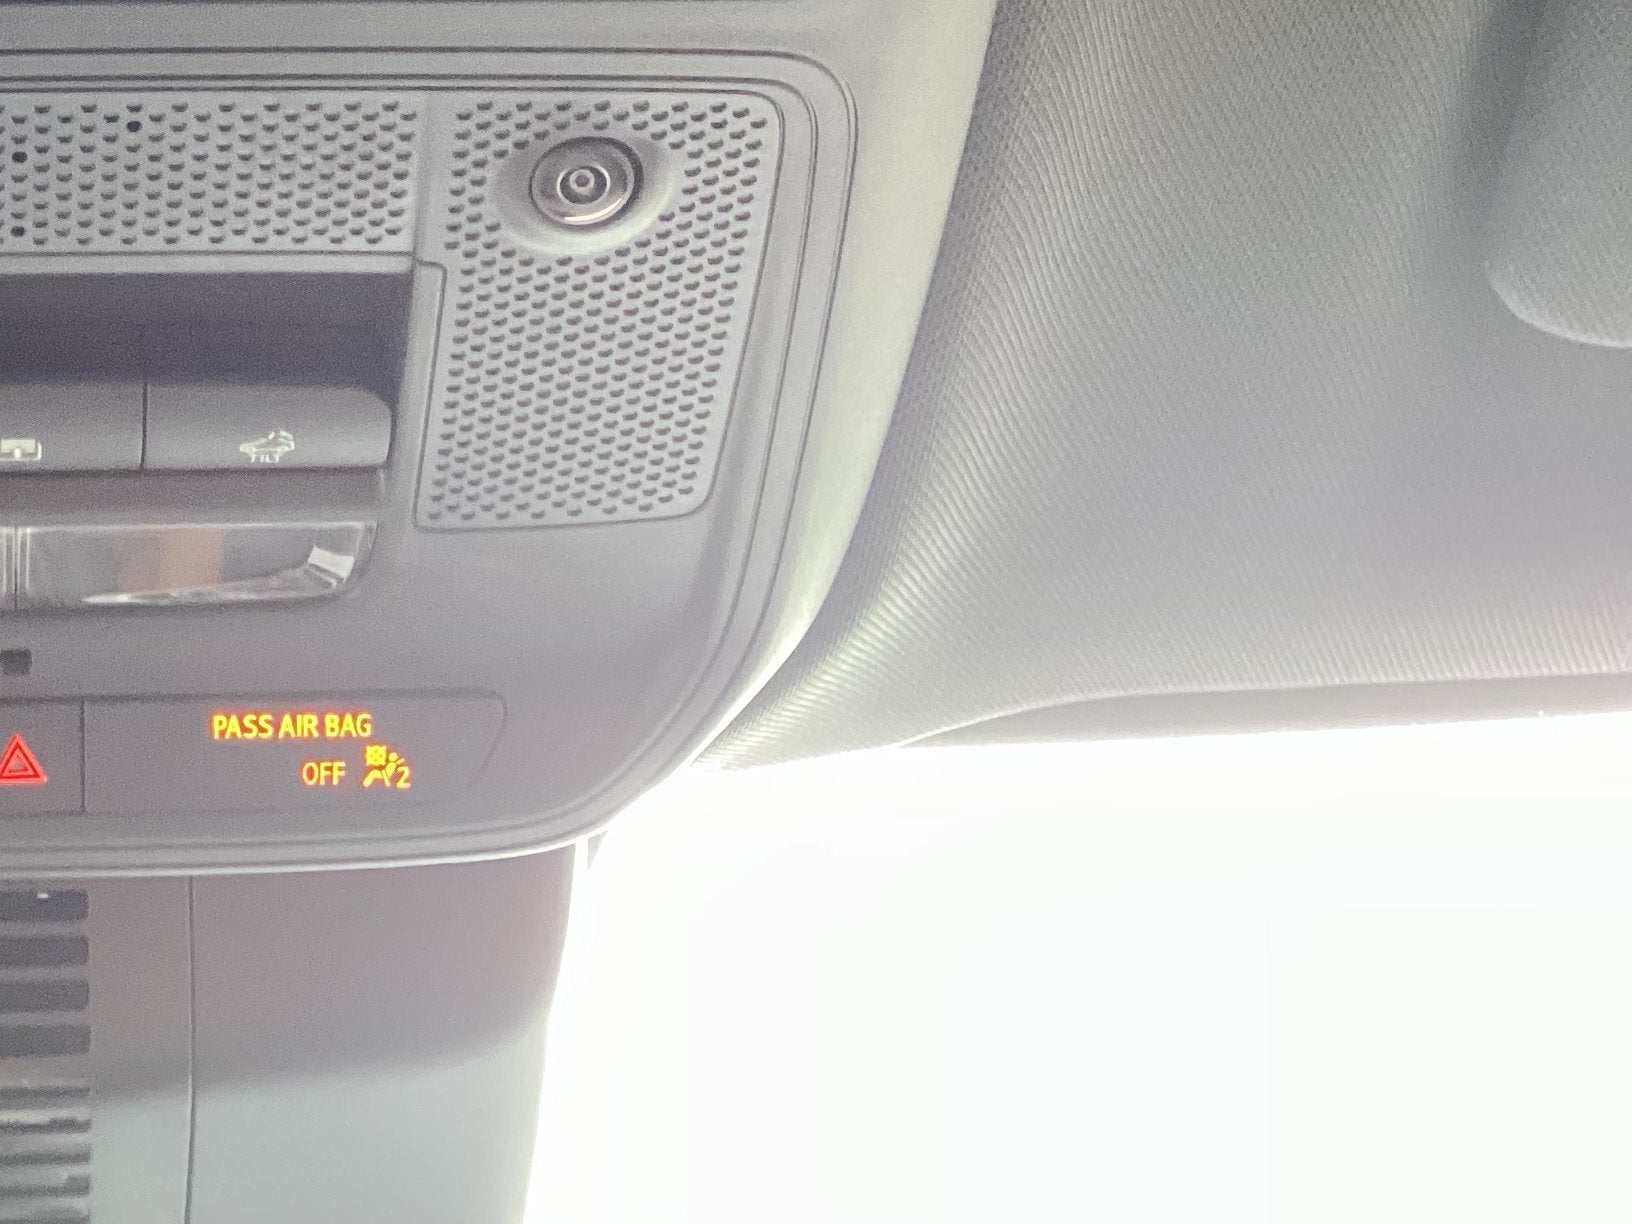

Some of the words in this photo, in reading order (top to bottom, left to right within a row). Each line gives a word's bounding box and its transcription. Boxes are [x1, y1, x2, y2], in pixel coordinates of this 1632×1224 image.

[248, 453, 280, 464] TILT
[212, 713, 274, 740] PASS
[278, 713, 319, 739] AIR
[324, 713, 372, 738] BAG
[302, 761, 347, 786] OFF
[396, 765, 412, 789] 2
